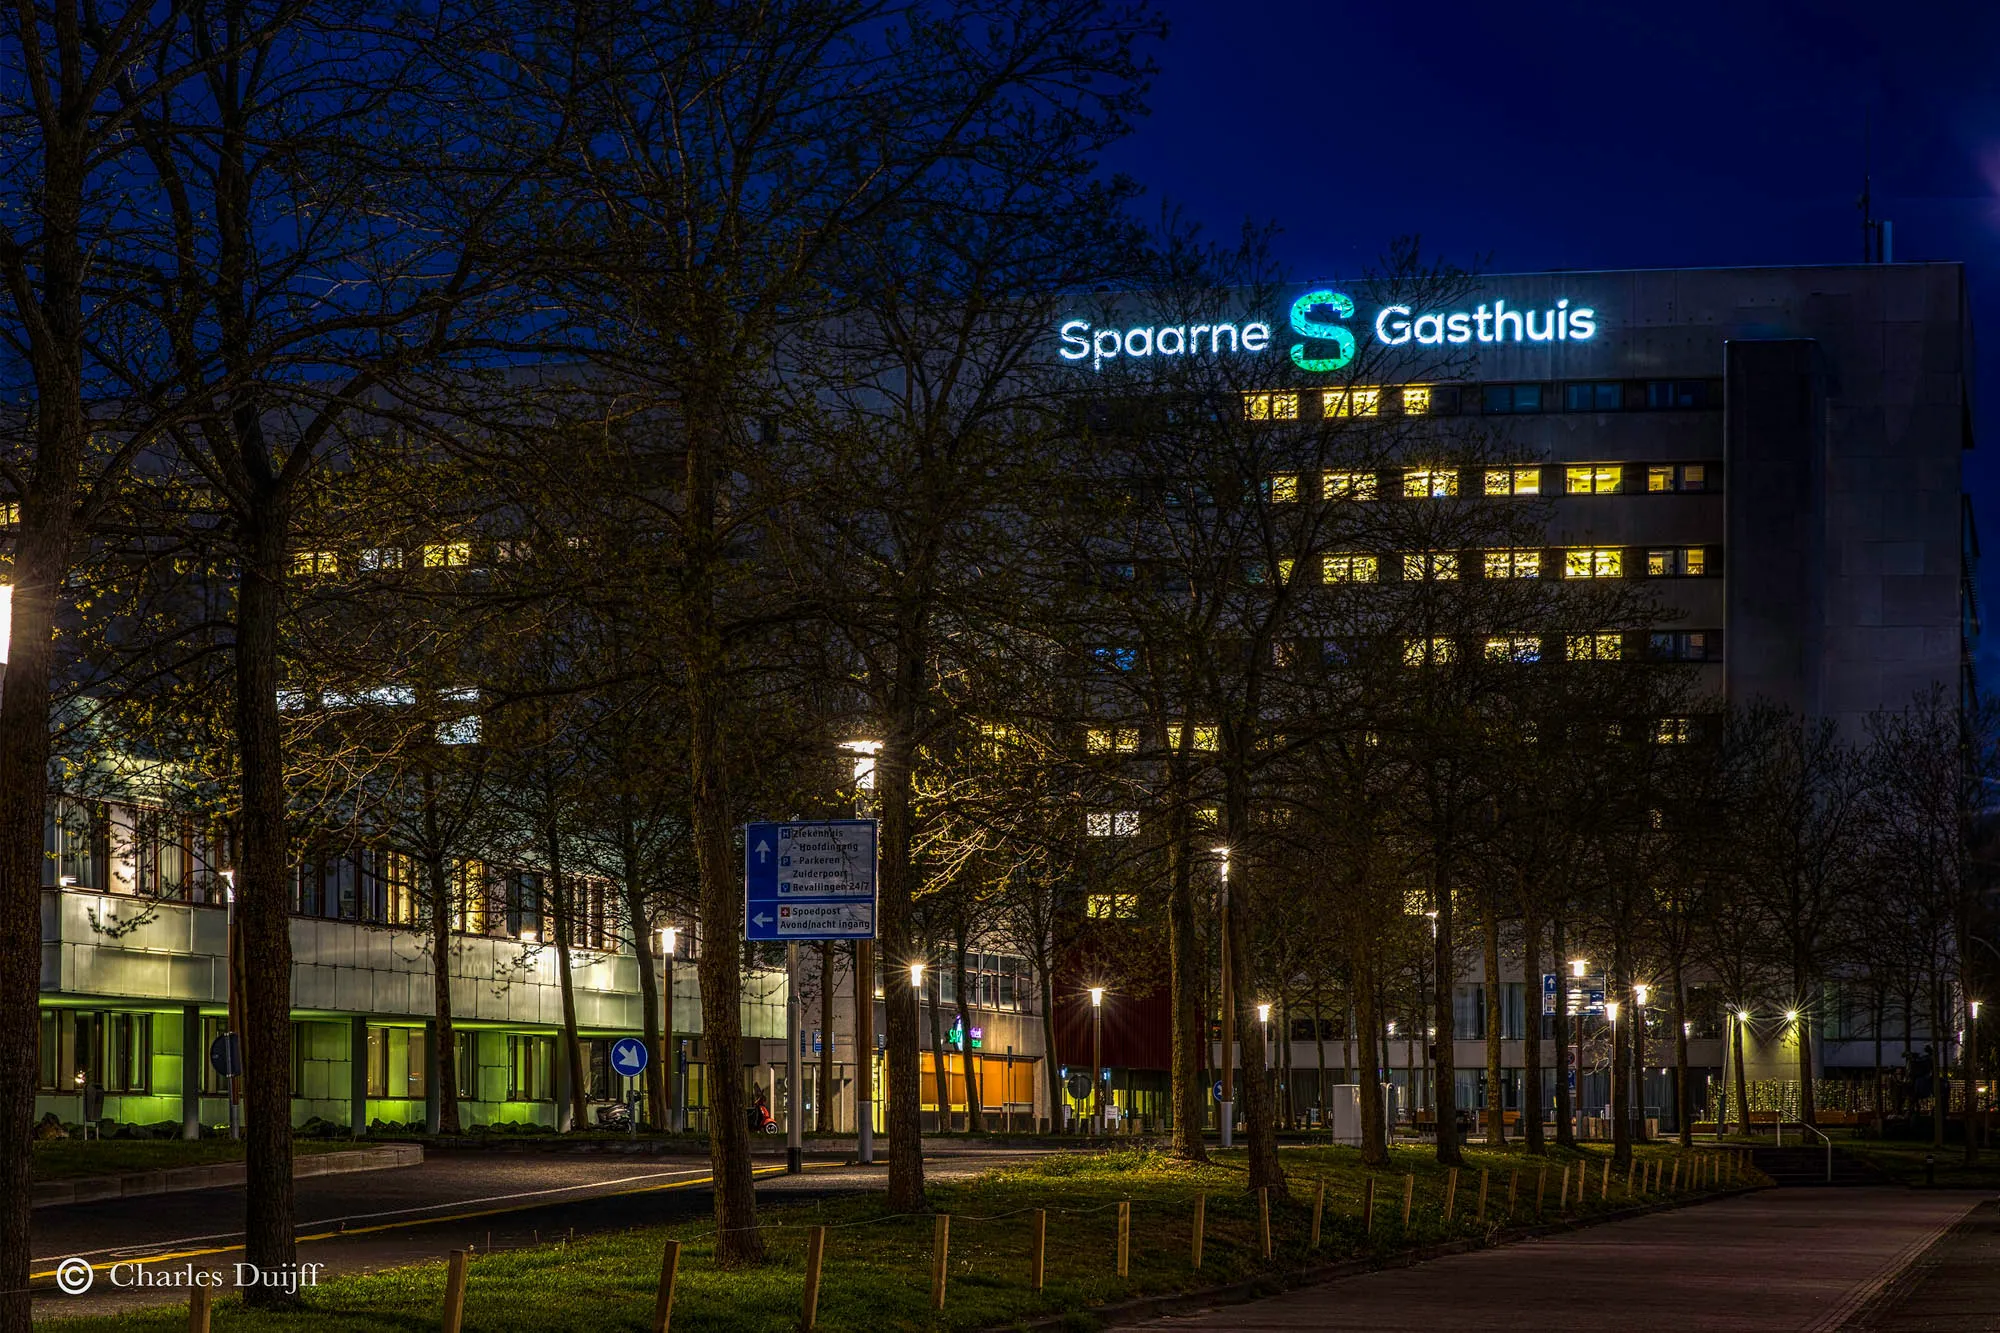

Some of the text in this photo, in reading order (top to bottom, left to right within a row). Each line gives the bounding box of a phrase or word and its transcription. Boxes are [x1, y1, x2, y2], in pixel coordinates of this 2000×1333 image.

[1059, 320, 1270, 371] Spaarne
[1376, 298, 1596, 345] Gasthuis
[792, 828, 844, 838] Ziekenhuis
[799, 842, 858, 852] Hoofdingang
[799, 856, 841, 865] Parkeren
[792, 870, 848, 880] Zuiderpoort
[792, 882, 870, 893] Bevallingen 24/7
[792, 907, 841, 917] Spoedpost
[780, 920, 870, 930] Avond/nacht ingang
